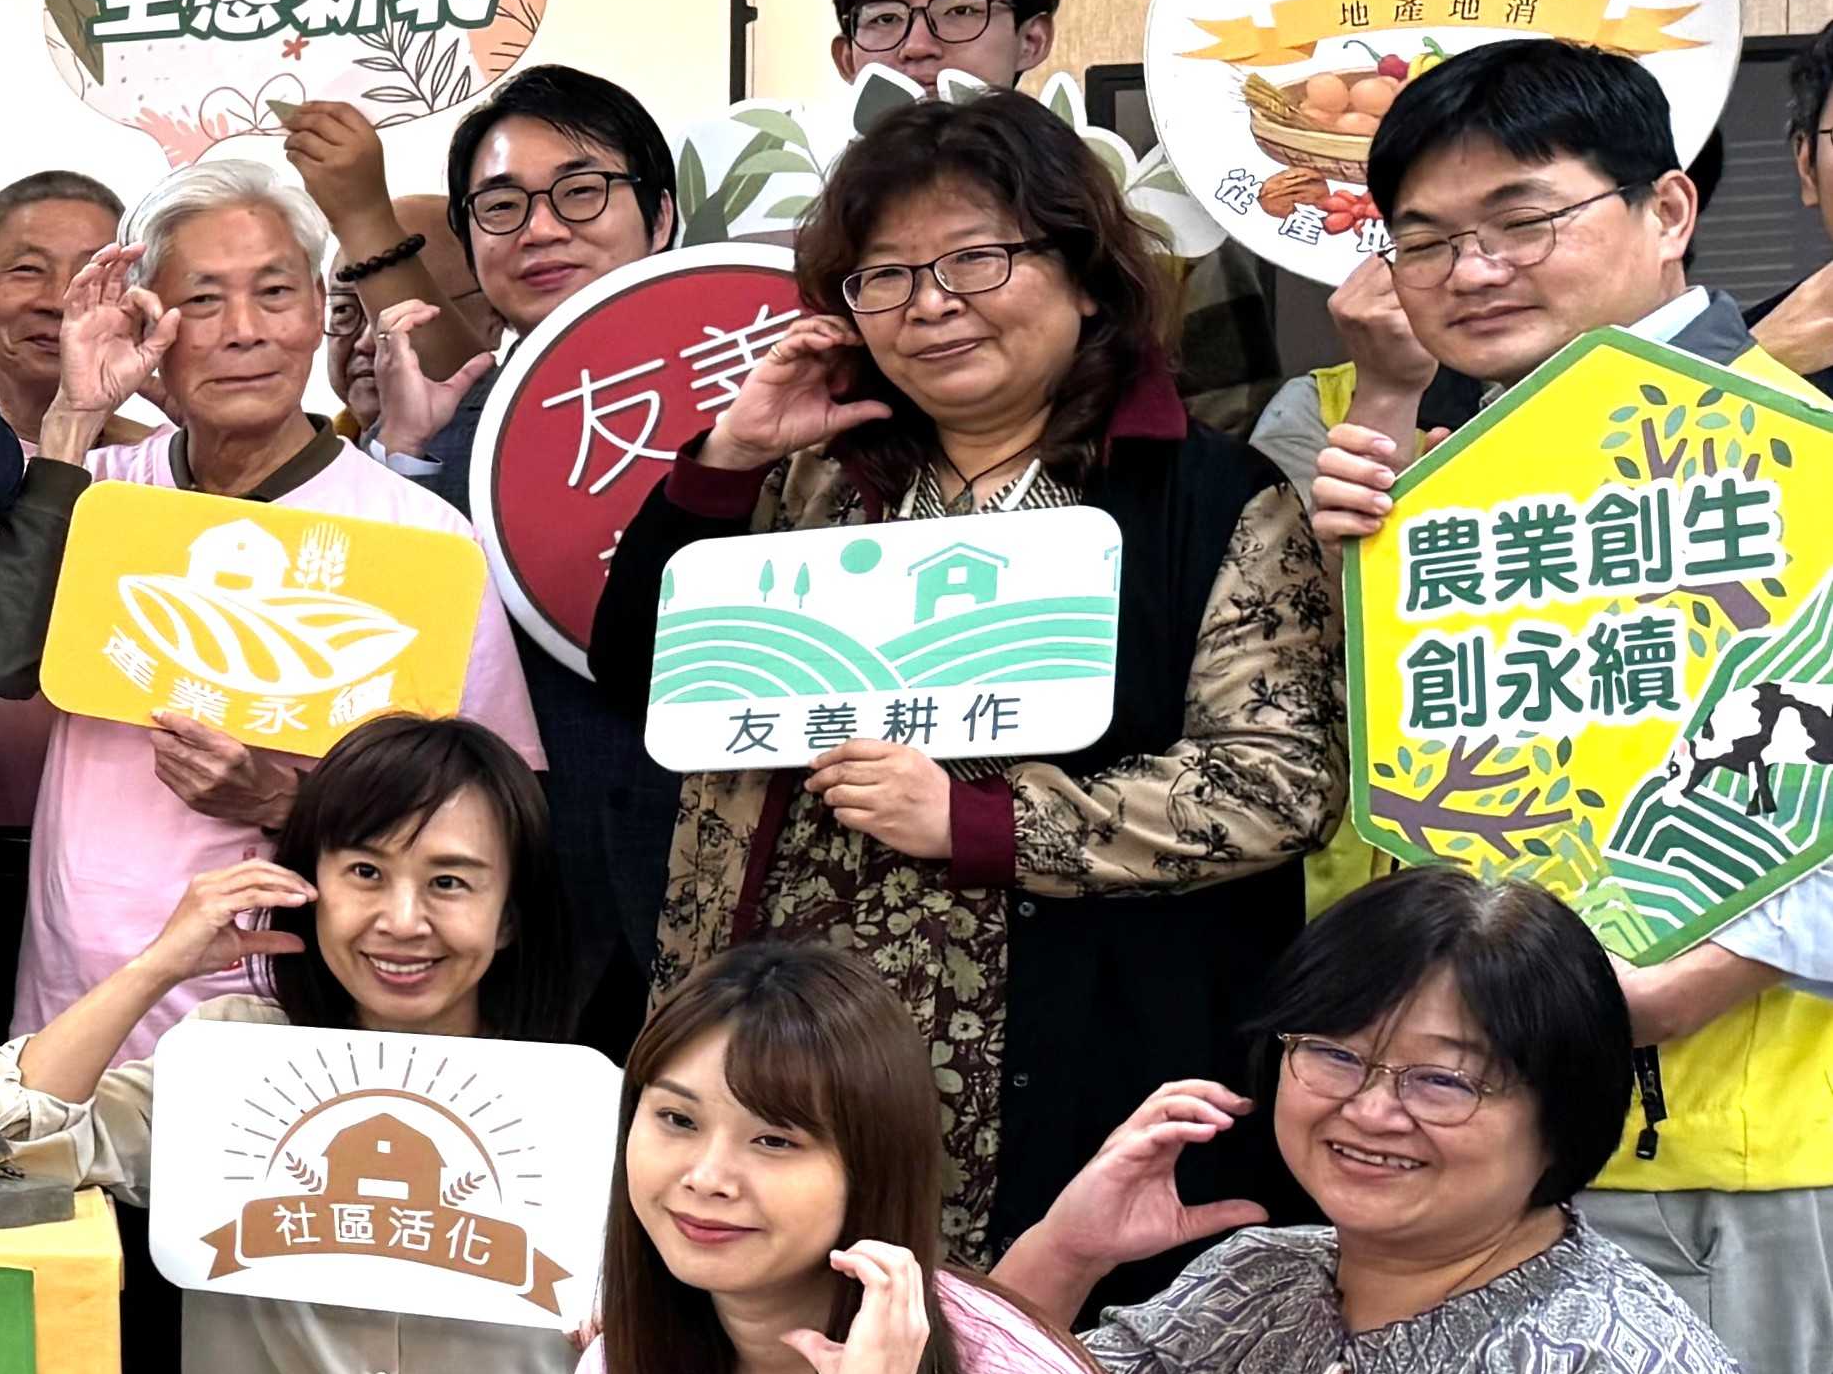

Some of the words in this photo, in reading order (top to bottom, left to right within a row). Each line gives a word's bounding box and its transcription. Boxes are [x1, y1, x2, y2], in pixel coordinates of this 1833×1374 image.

[1406, 478, 1776, 611] 農業創生
[103, 624, 397, 734] 產業永續
[726, 693, 1021, 754] 友善耕作
[1407, 615, 1681, 729] 創永續
[273, 1201, 492, 1266] 社區活化
